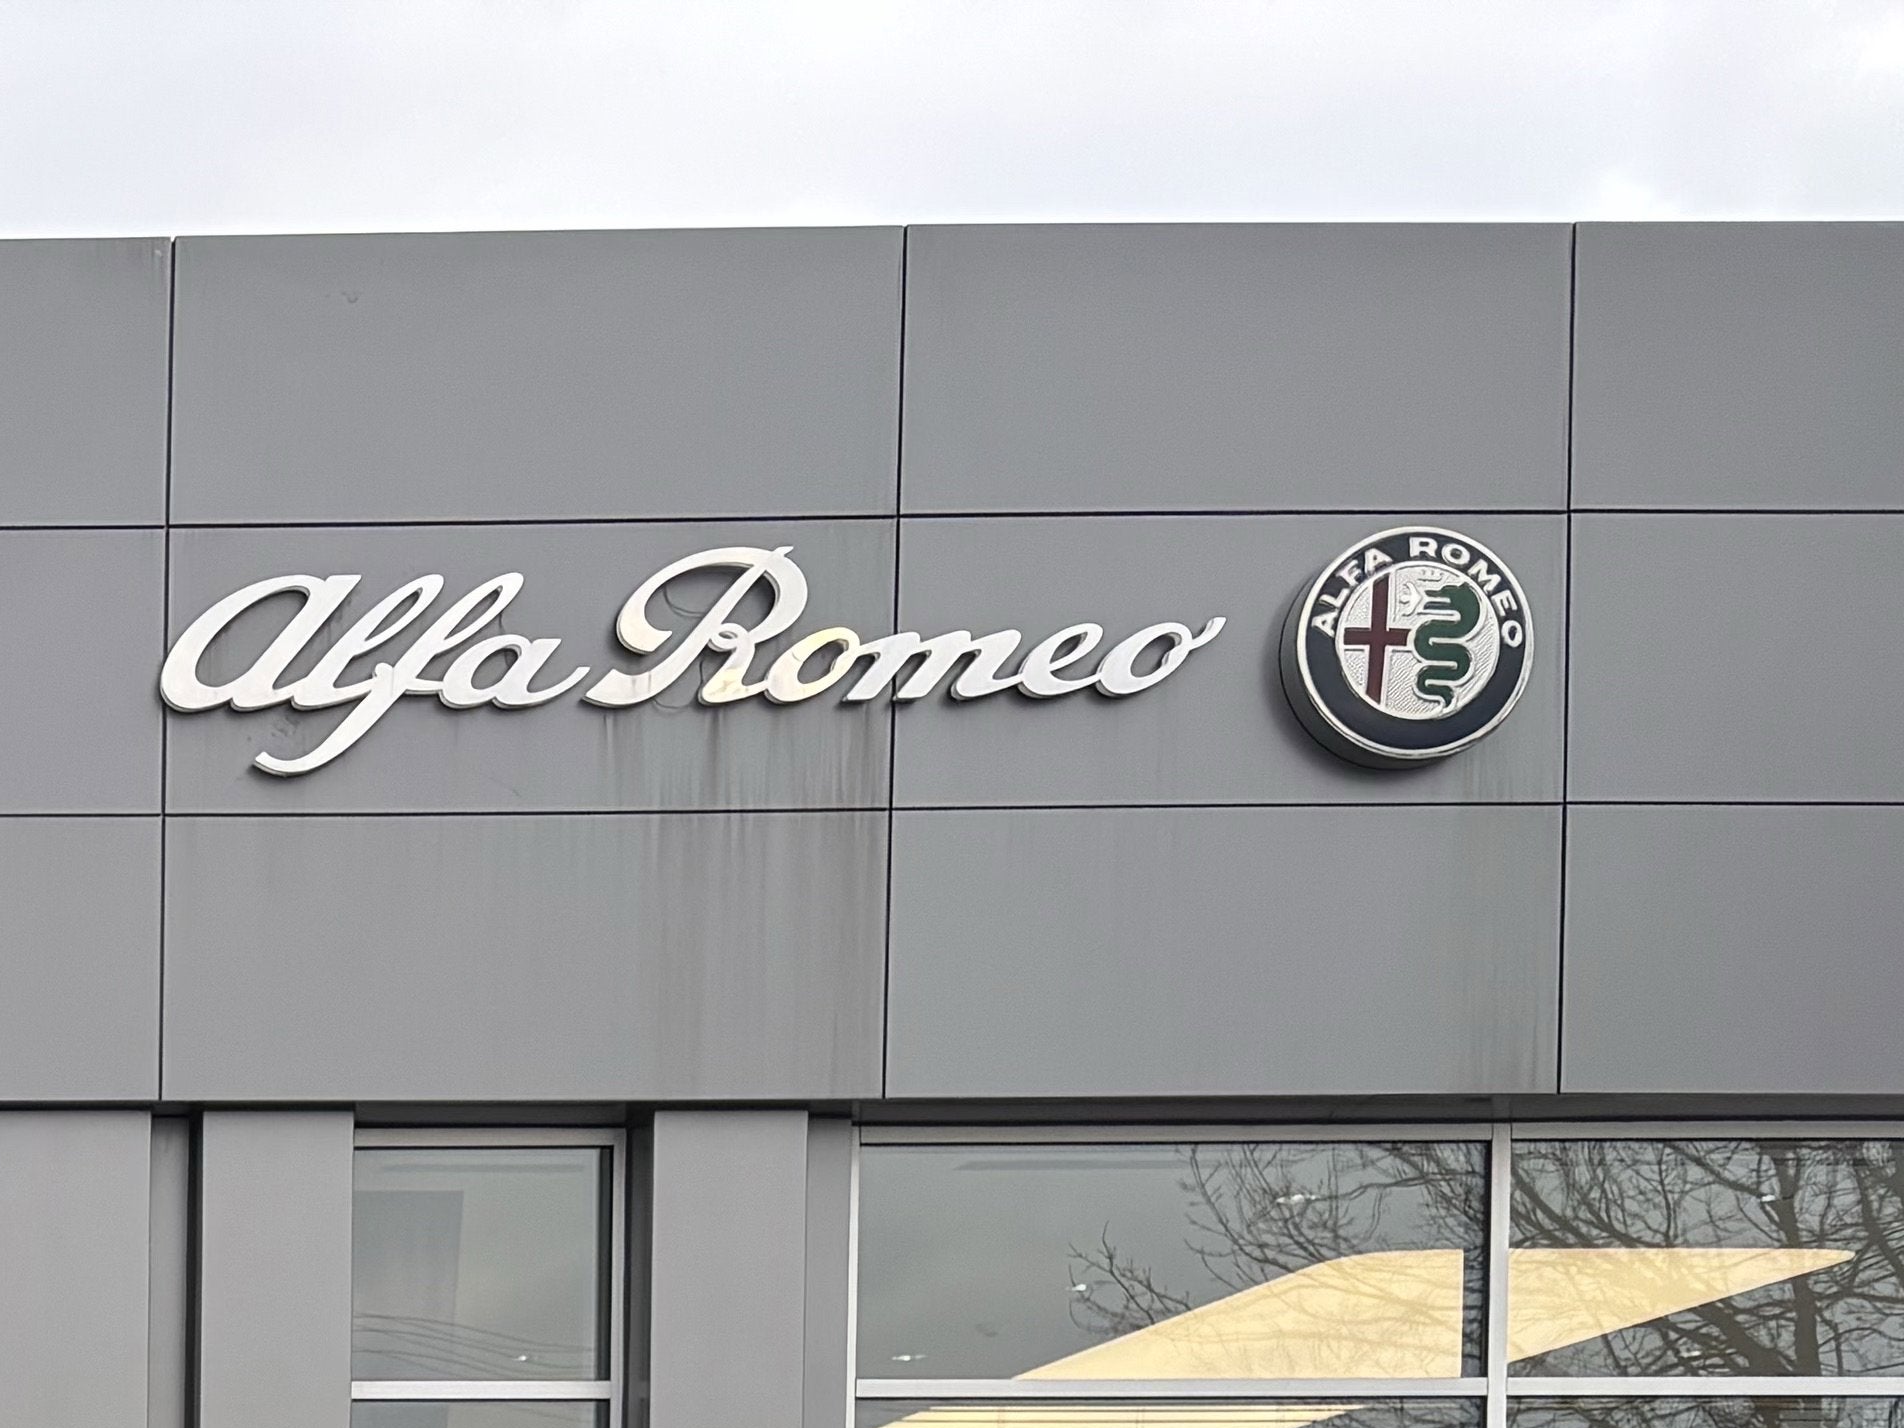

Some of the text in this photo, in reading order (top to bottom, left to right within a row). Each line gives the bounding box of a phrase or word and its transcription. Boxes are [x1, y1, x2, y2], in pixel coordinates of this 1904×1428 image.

[160, 546, 1228, 777] Alfa Romeo
[1310, 535, 1524, 648] ALFA ROMEO
